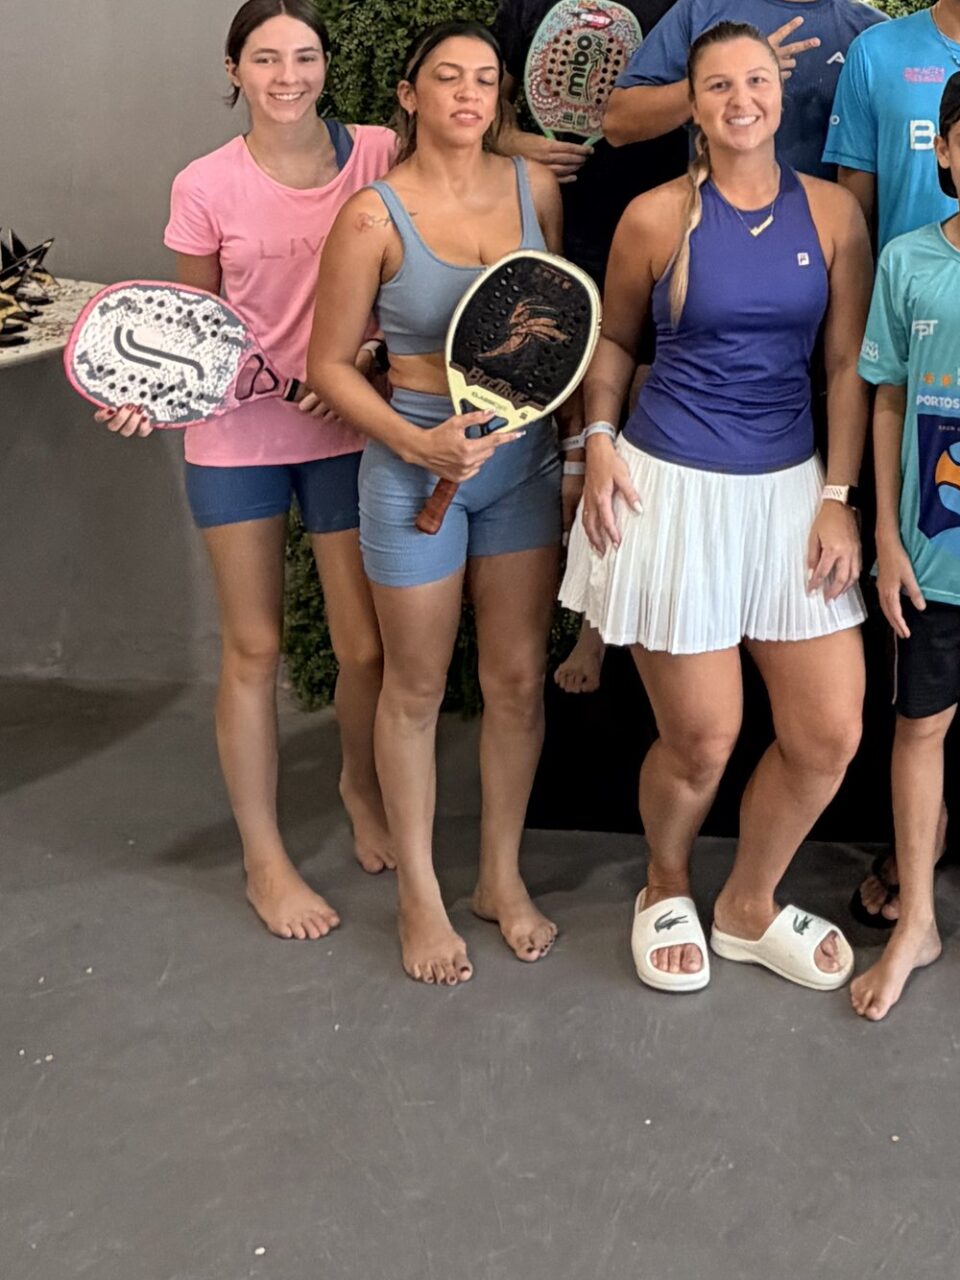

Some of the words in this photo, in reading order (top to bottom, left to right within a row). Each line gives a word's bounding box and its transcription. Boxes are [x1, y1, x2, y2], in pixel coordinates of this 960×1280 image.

[568, 35, 592, 97] mibo
[260, 235, 325, 260] LIV
[916, 395, 960, 410] PORTOS
